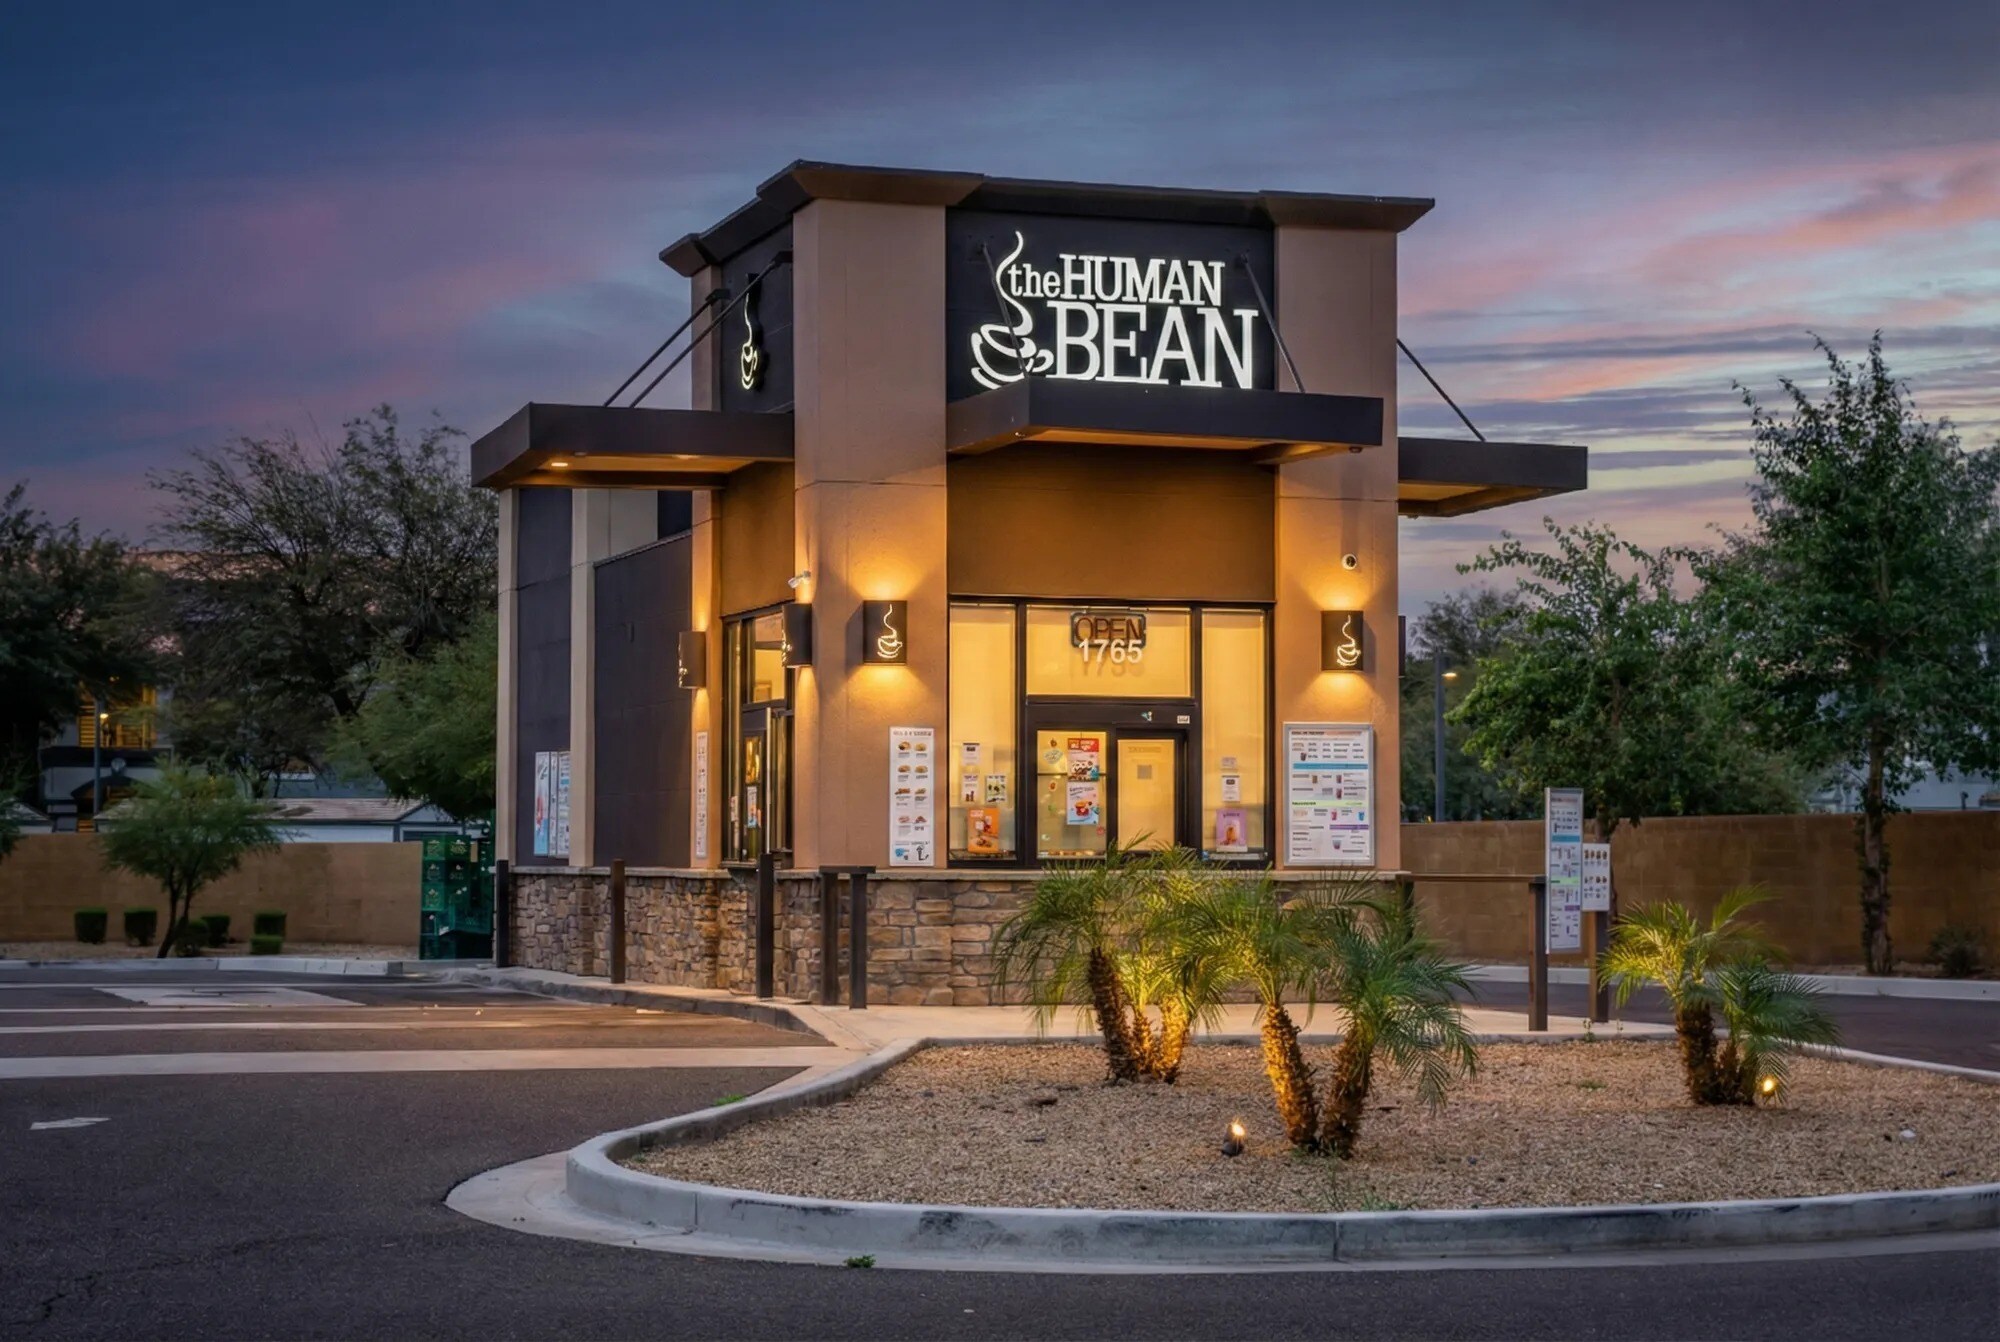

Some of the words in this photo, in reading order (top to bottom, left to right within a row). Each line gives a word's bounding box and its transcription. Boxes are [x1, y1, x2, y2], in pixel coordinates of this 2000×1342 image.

[1009, 263, 1060, 299] the
[1059, 253, 1225, 306] HUMAN
[1046, 300, 1259, 389] BEAN
[1075, 616, 1142, 642] OPEN
[1078, 638, 1143, 664] 1765
